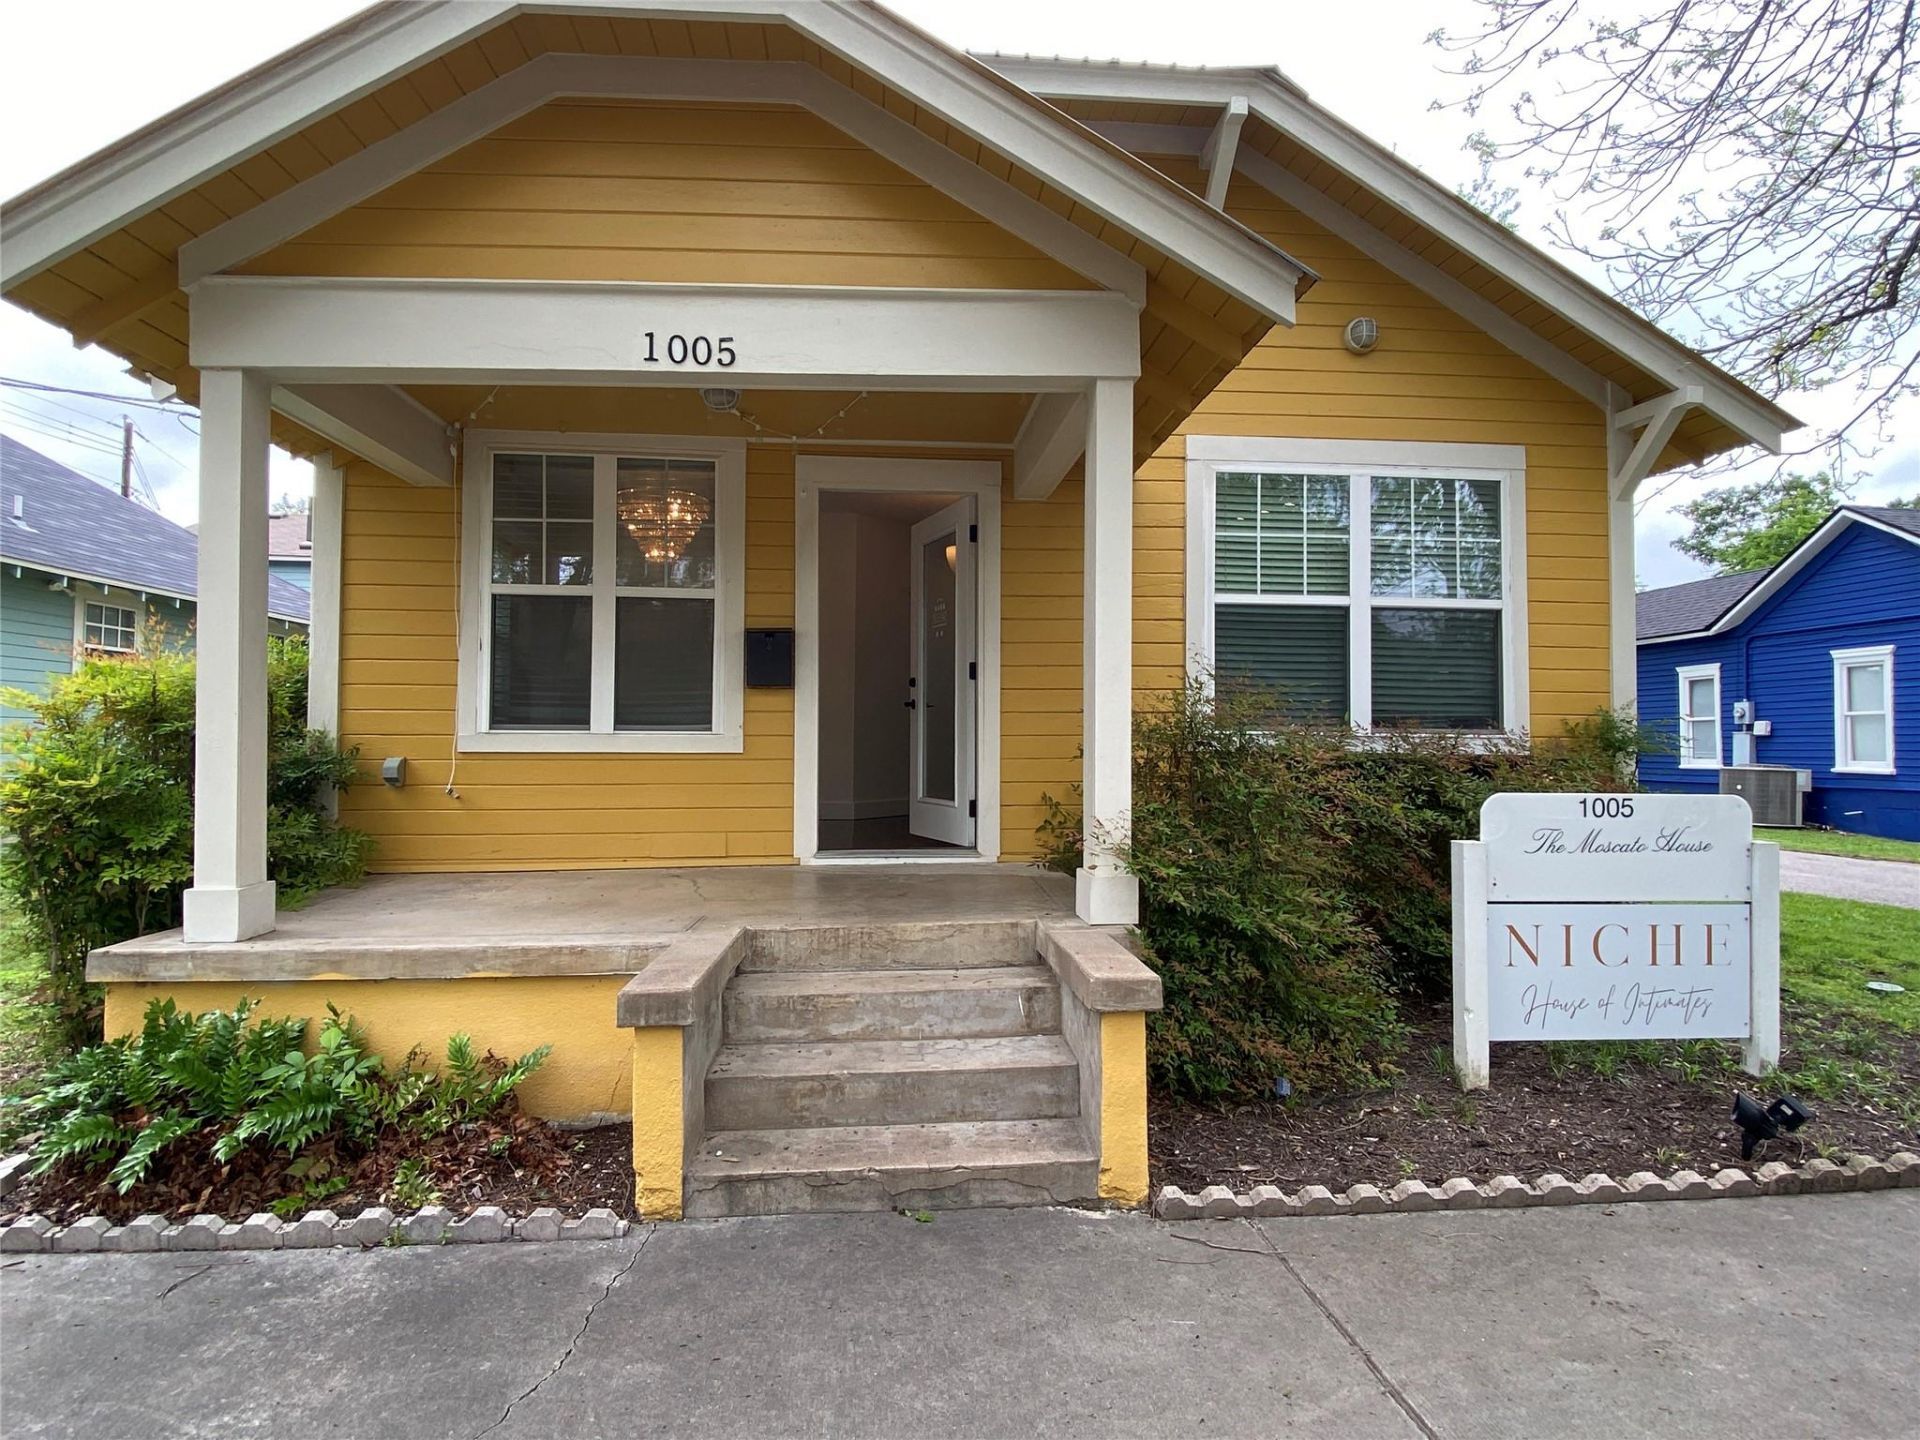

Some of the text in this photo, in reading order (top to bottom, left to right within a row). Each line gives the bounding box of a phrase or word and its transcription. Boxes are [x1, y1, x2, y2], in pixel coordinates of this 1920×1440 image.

[643, 332, 736, 367] 1005
[1578, 797, 1634, 818] 1005
[1524, 826, 1714, 854] The Moscato House
[1503, 923, 1732, 968] NICHE
[1521, 979, 1714, 1029] House of Intimates
